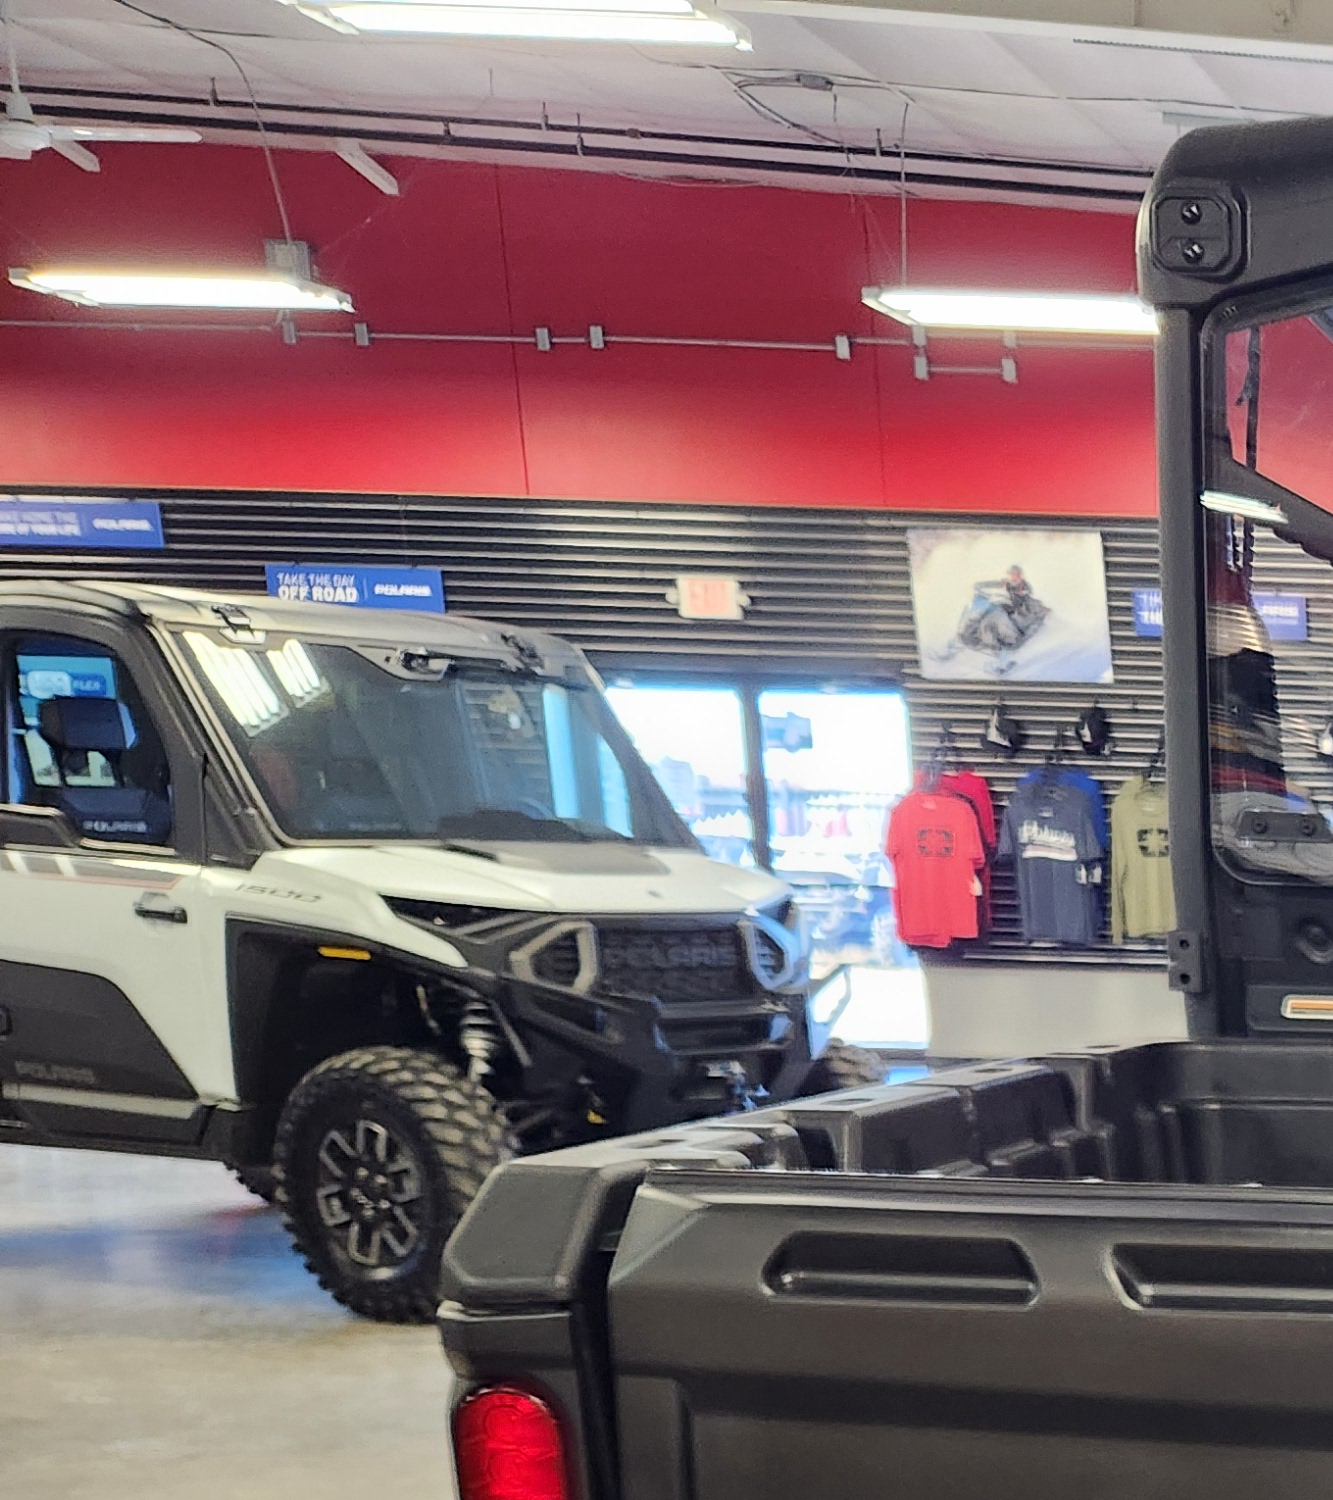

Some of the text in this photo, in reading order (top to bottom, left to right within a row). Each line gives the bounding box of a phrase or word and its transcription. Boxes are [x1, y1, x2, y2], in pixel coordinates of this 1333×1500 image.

[276, 572, 355, 587] TAKE THE DAY
[278, 585, 359, 603] OFF ROAD
[374, 583, 432, 597] POLARIS
